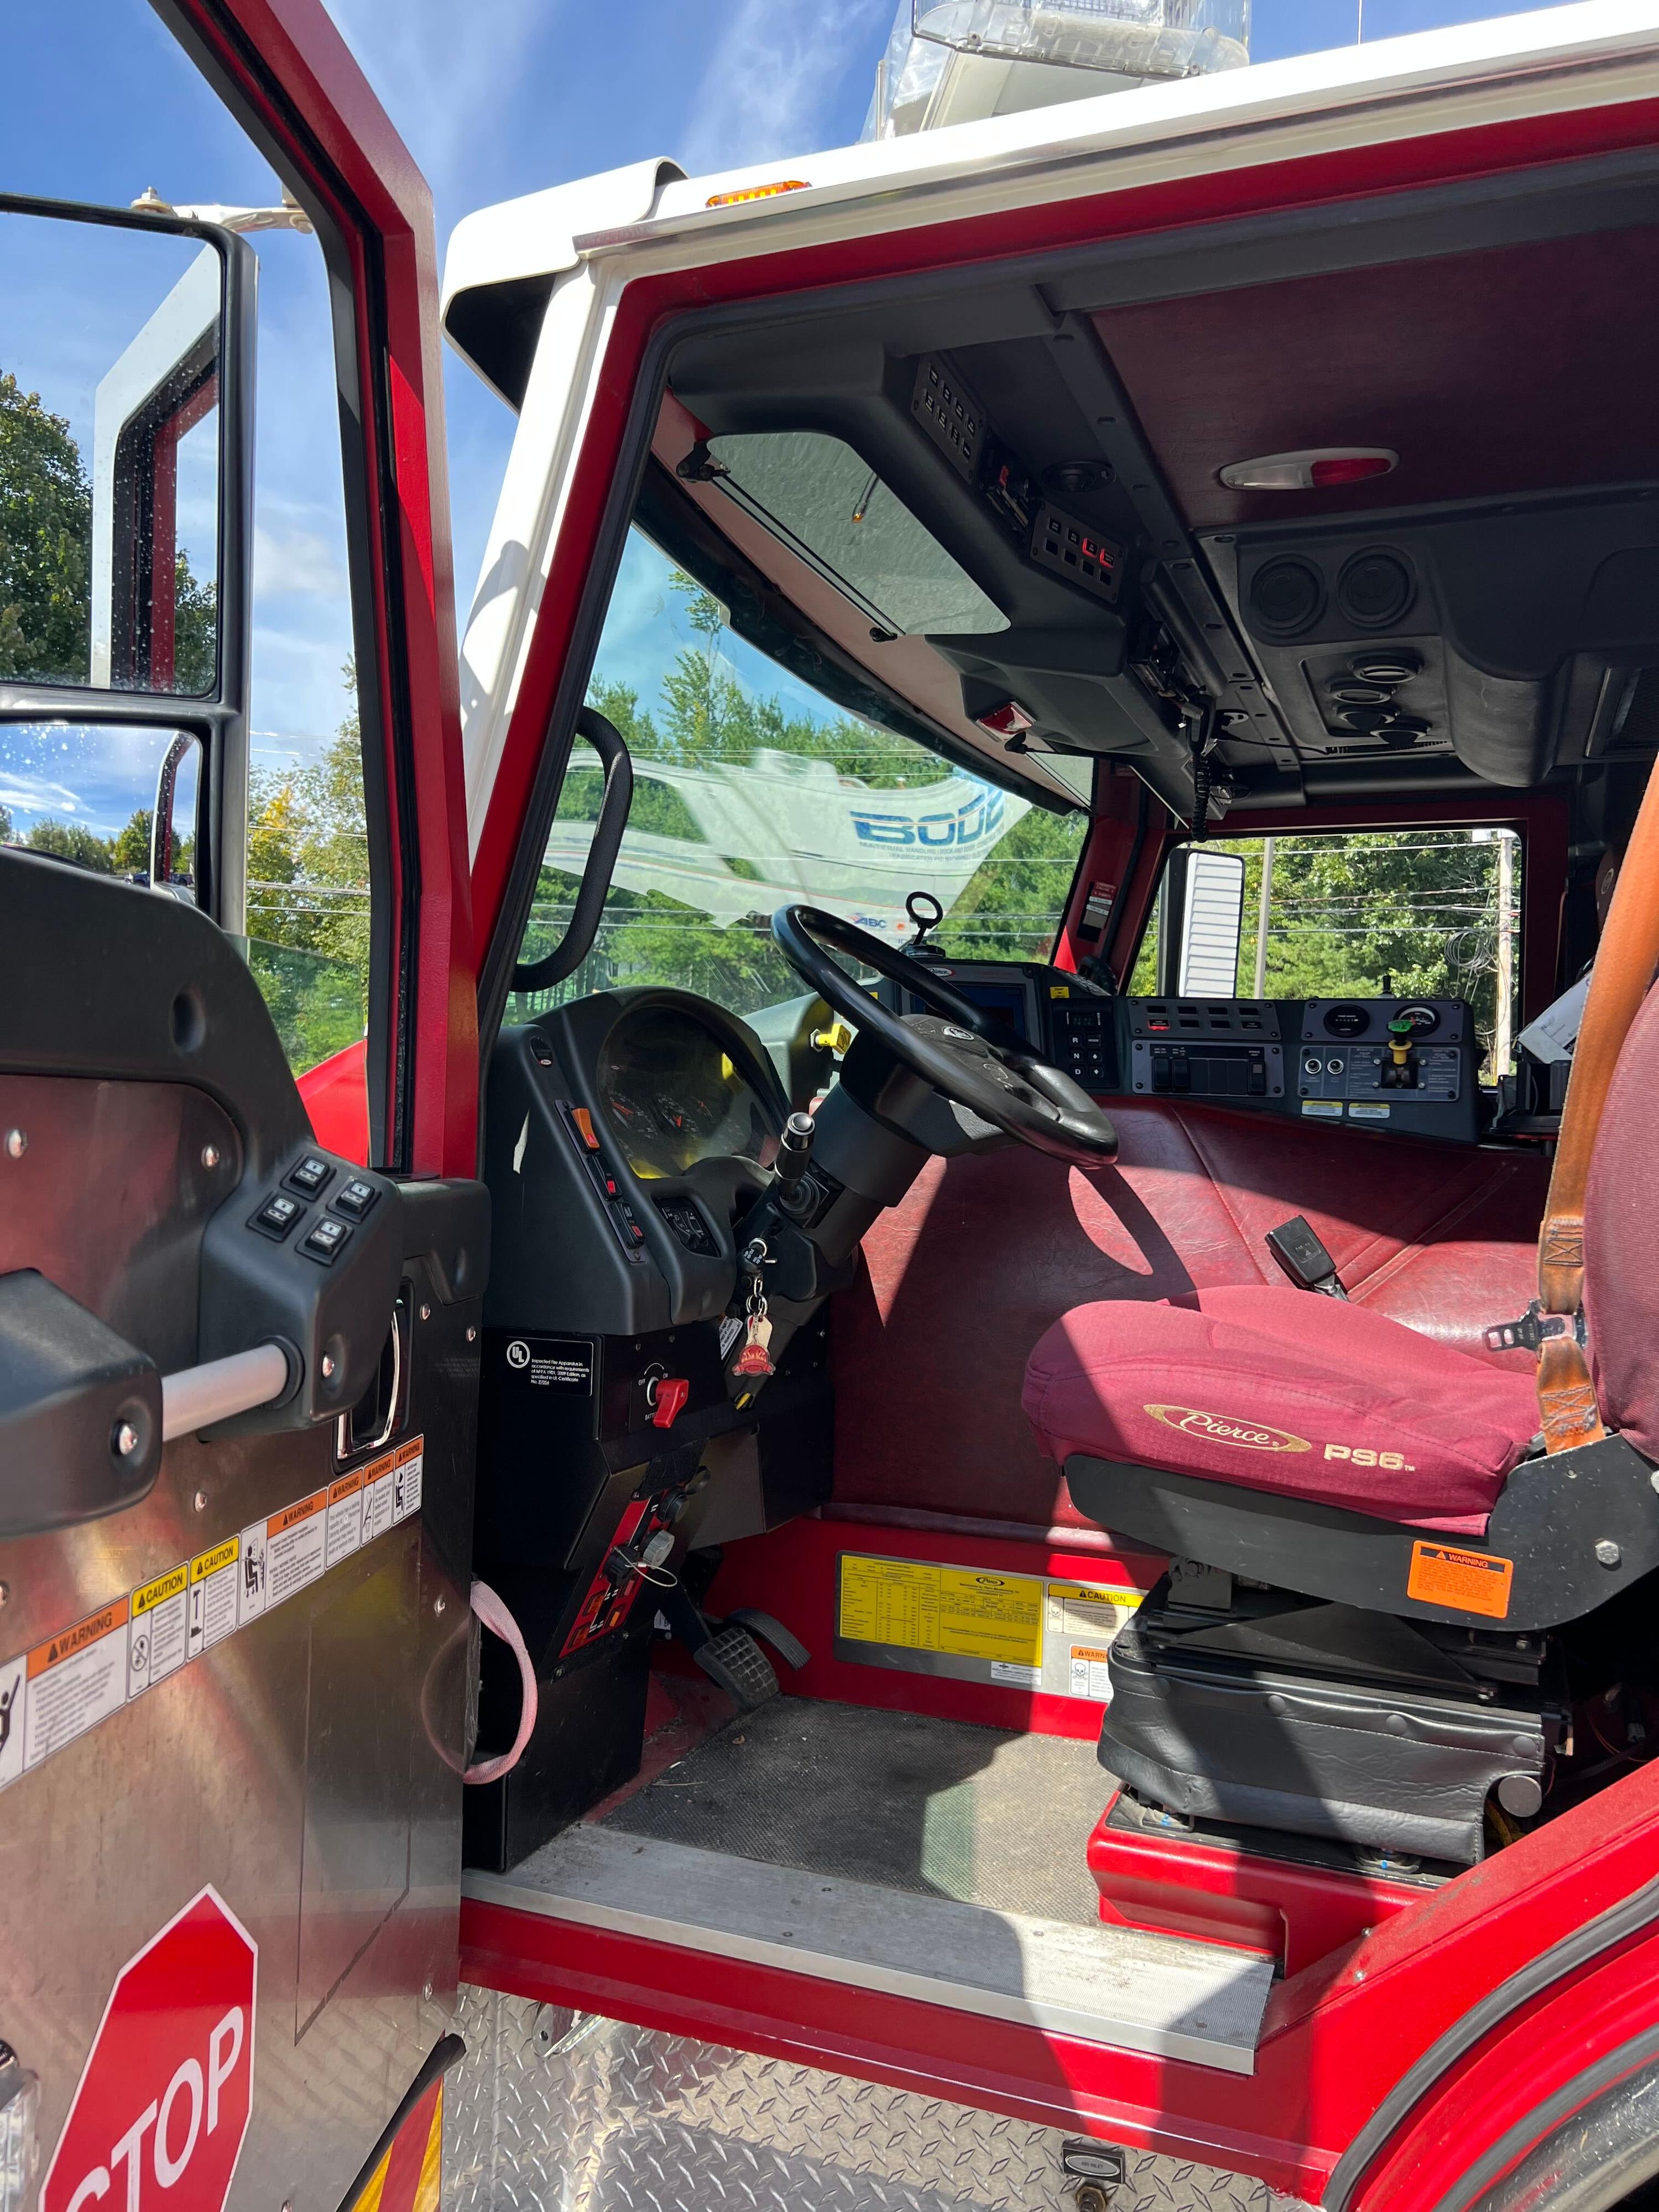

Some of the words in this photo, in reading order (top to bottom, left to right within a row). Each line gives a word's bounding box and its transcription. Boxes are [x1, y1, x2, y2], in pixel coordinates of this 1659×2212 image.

[855, 917, 886, 928] ABC
[512, 1346, 524, 1363] UL
[1179, 1411, 1270, 1444] Pierce
[402, 1442, 420, 1459] WARNING
[371, 1459, 391, 1478] WARNING
[337, 1476, 359, 1495] WARNING
[288, 1501, 314, 1523] WARNING
[204, 1545, 234, 1571] CAUTION
[1448, 1553, 1489, 1568] WARNING
[146, 1572, 183, 1604] CAUTION
[1087, 1591, 1126, 1603] CAUTION
[59, 1611, 113, 1655] WARNING
